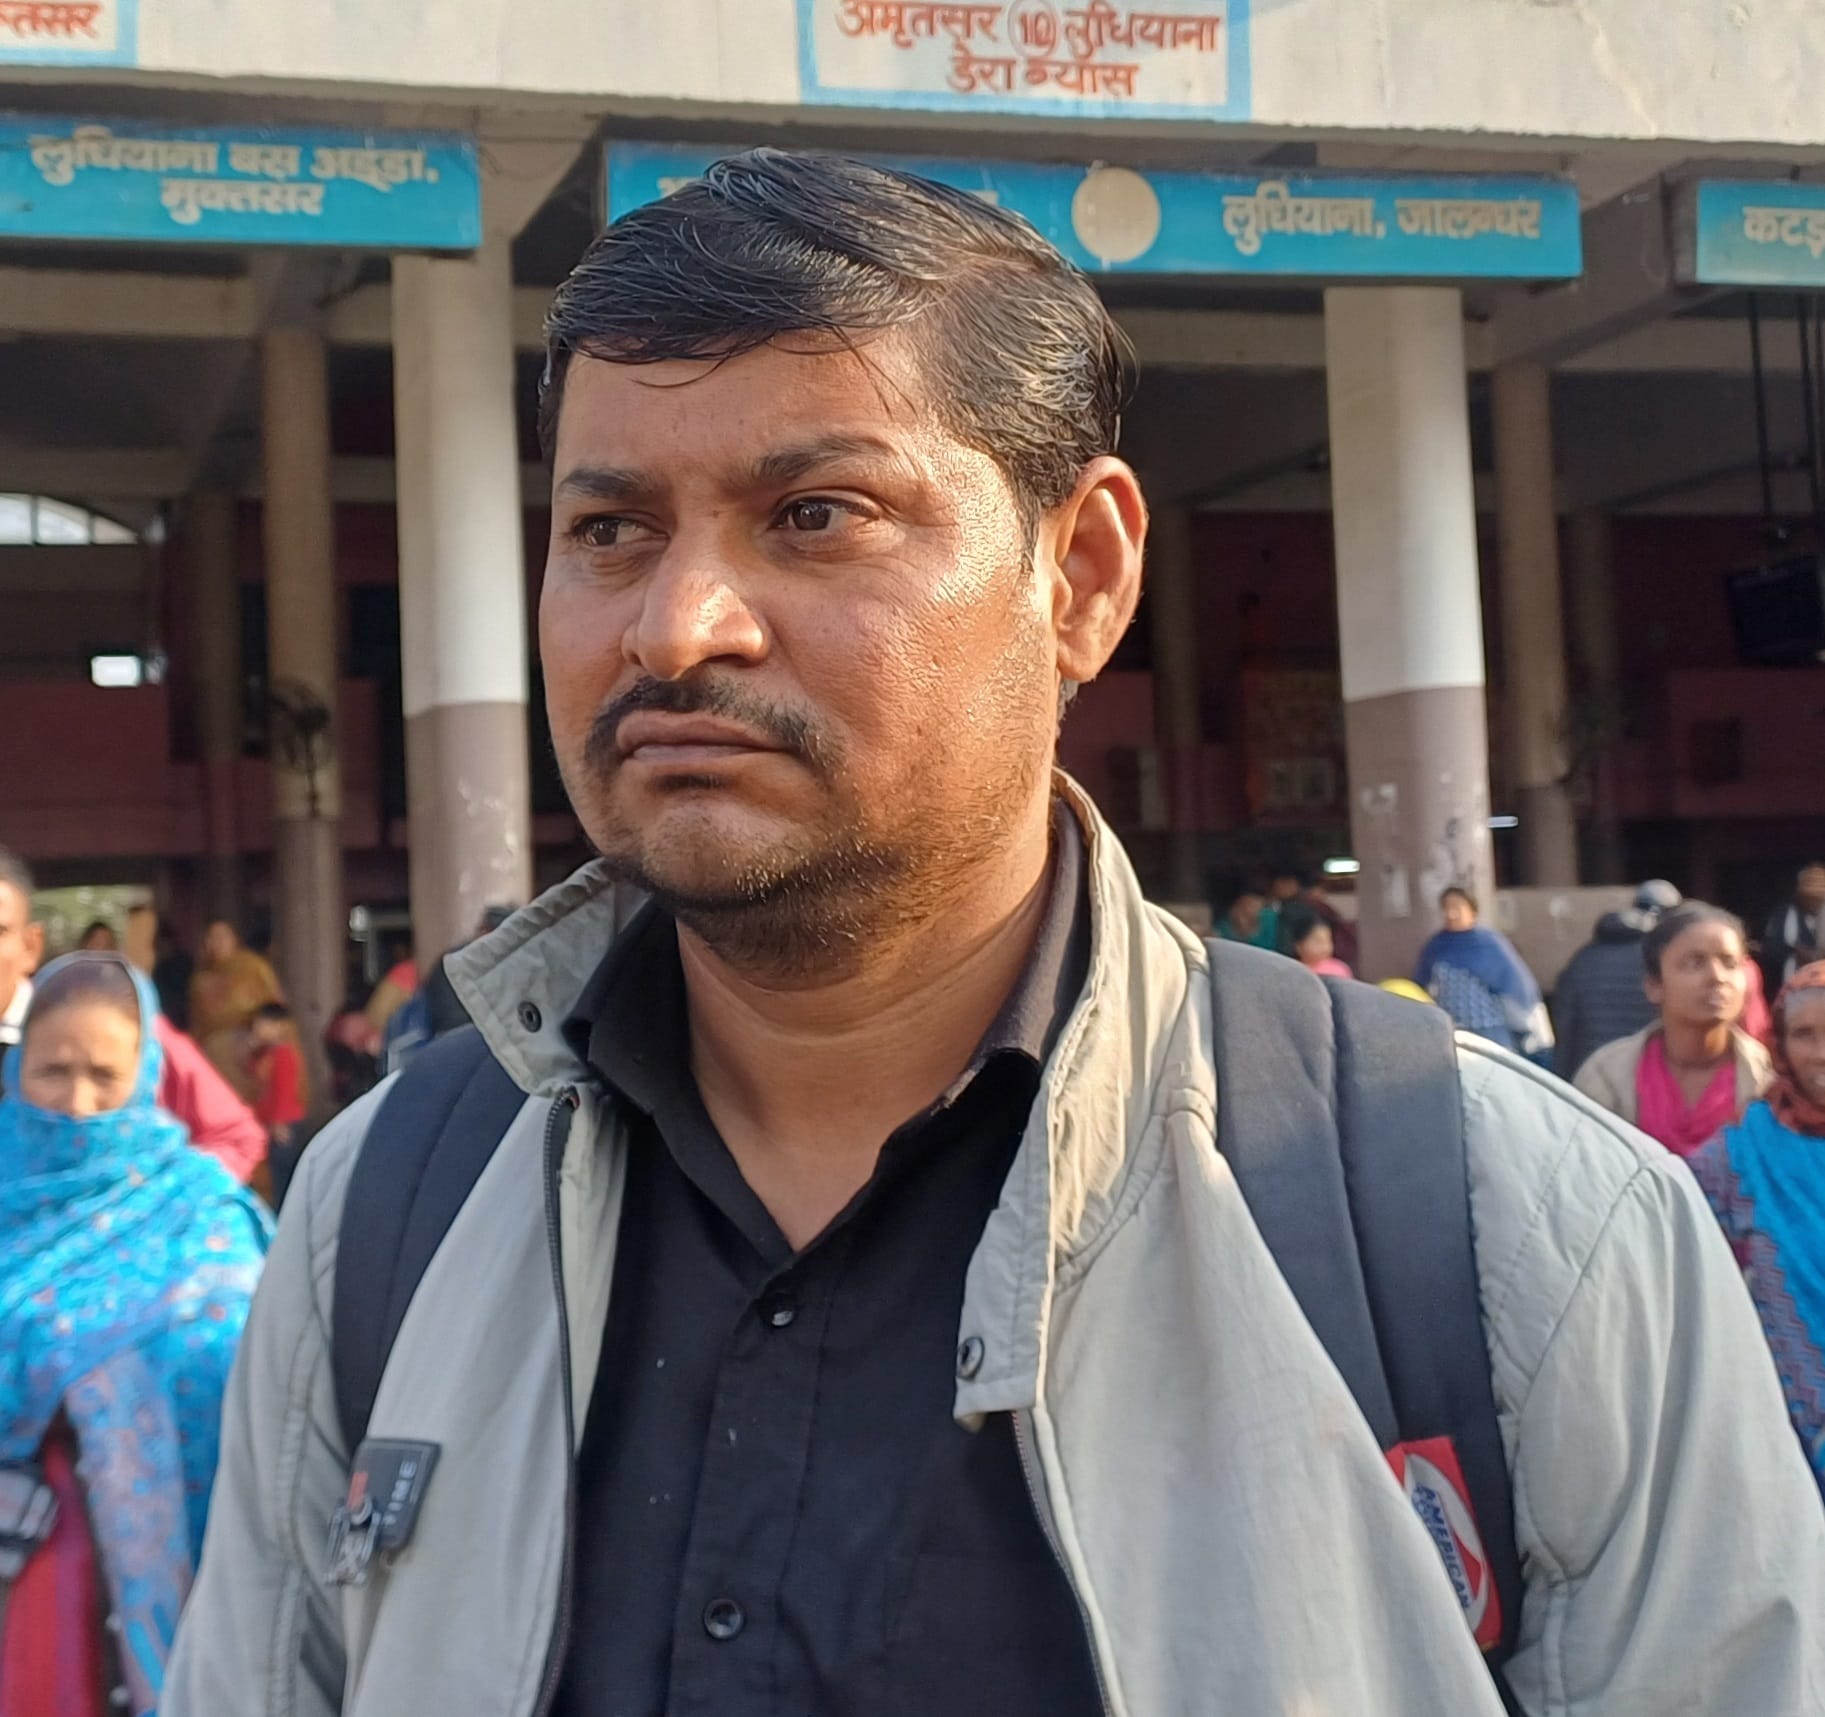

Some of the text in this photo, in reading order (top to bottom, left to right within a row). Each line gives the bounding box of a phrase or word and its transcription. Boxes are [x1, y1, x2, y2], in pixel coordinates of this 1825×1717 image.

[835, 0, 1002, 49] अमृतसर
[1065, 0, 1220, 60] लुधियाना
[946, 41, 1140, 96] डेरा ब्यास
[30, 125, 218, 186] लुधियाना
